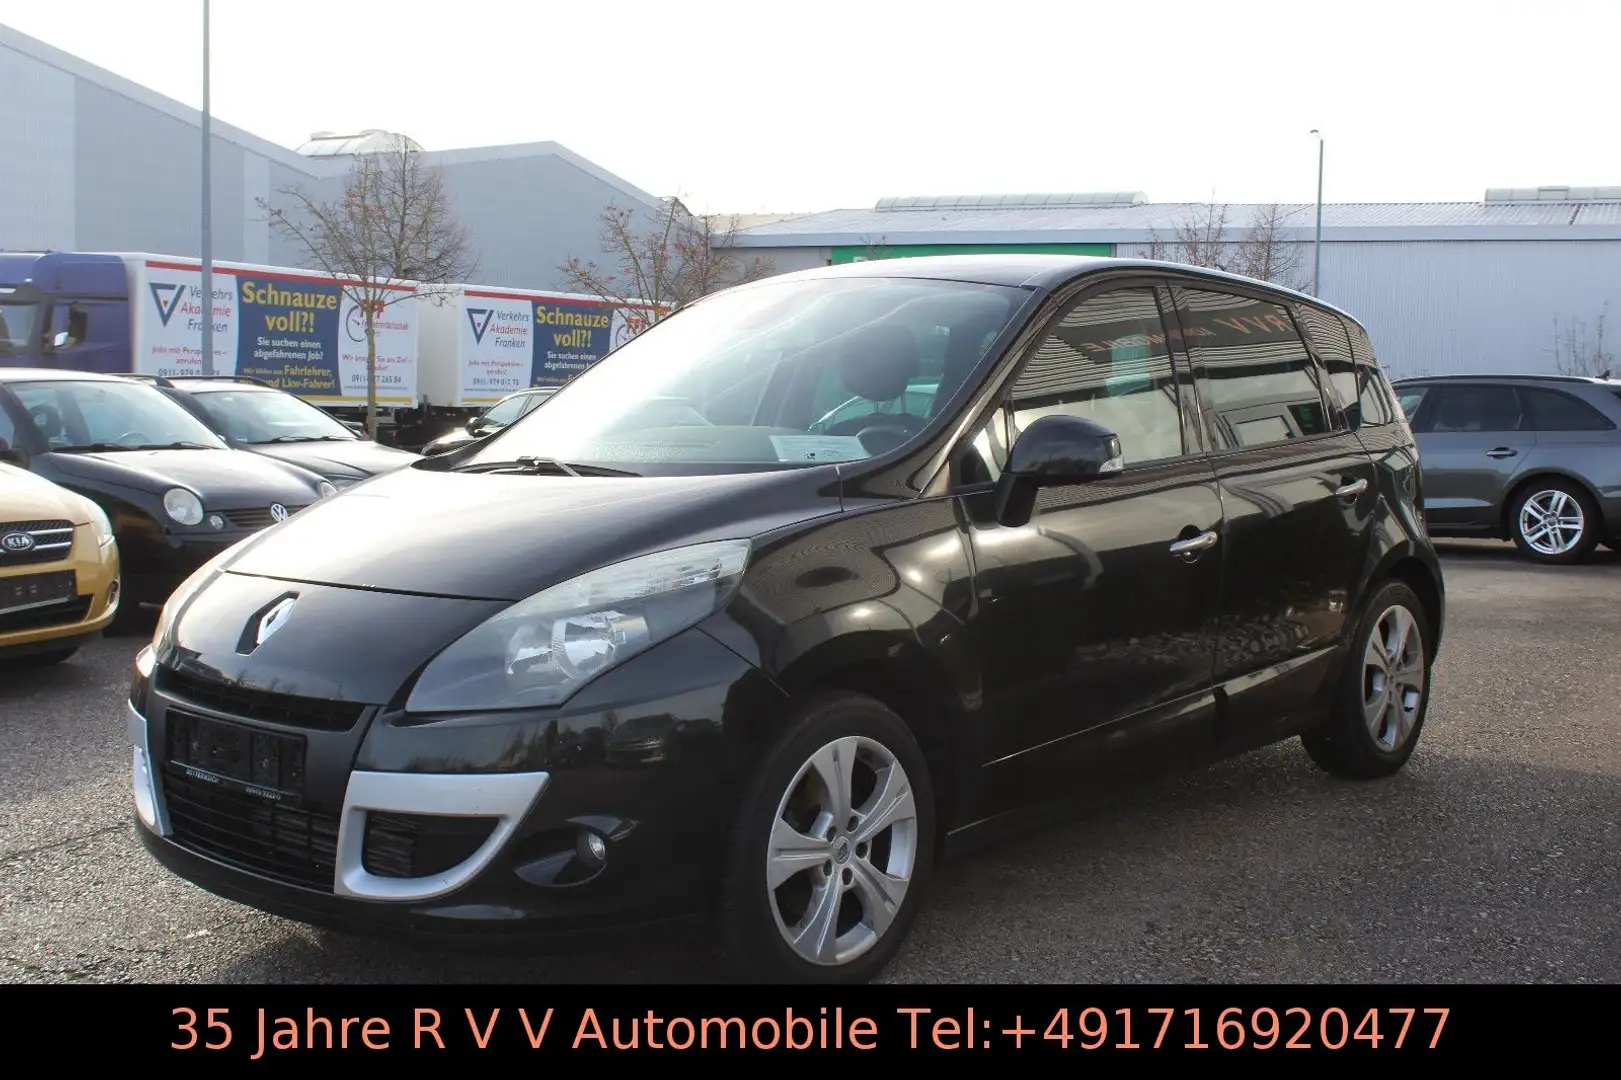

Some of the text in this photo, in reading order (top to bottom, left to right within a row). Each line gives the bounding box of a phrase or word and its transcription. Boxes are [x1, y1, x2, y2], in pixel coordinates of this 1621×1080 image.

[189, 285, 233, 301] Veehrs
[242, 279, 337, 310] Schnauze
[180, 302, 231, 317] Akamie
[496, 310, 530, 322] Verkehrs
[536, 305, 609, 328] Schnauze
[187, 319, 228, 333] Fraken
[265, 310, 315, 333] voll?!
[490, 324, 528, 336] Akademie
[257, 336, 321, 350] Sie suchen einen
[495, 337, 525, 348] Franken
[553, 329, 592, 349] voll?!
[253, 348, 306, 361] abgefahrenen
[547, 351, 597, 361] Sie suchen einen
[544, 361, 585, 371] abgefahrenen
[7, 535, 30, 548] KIA
